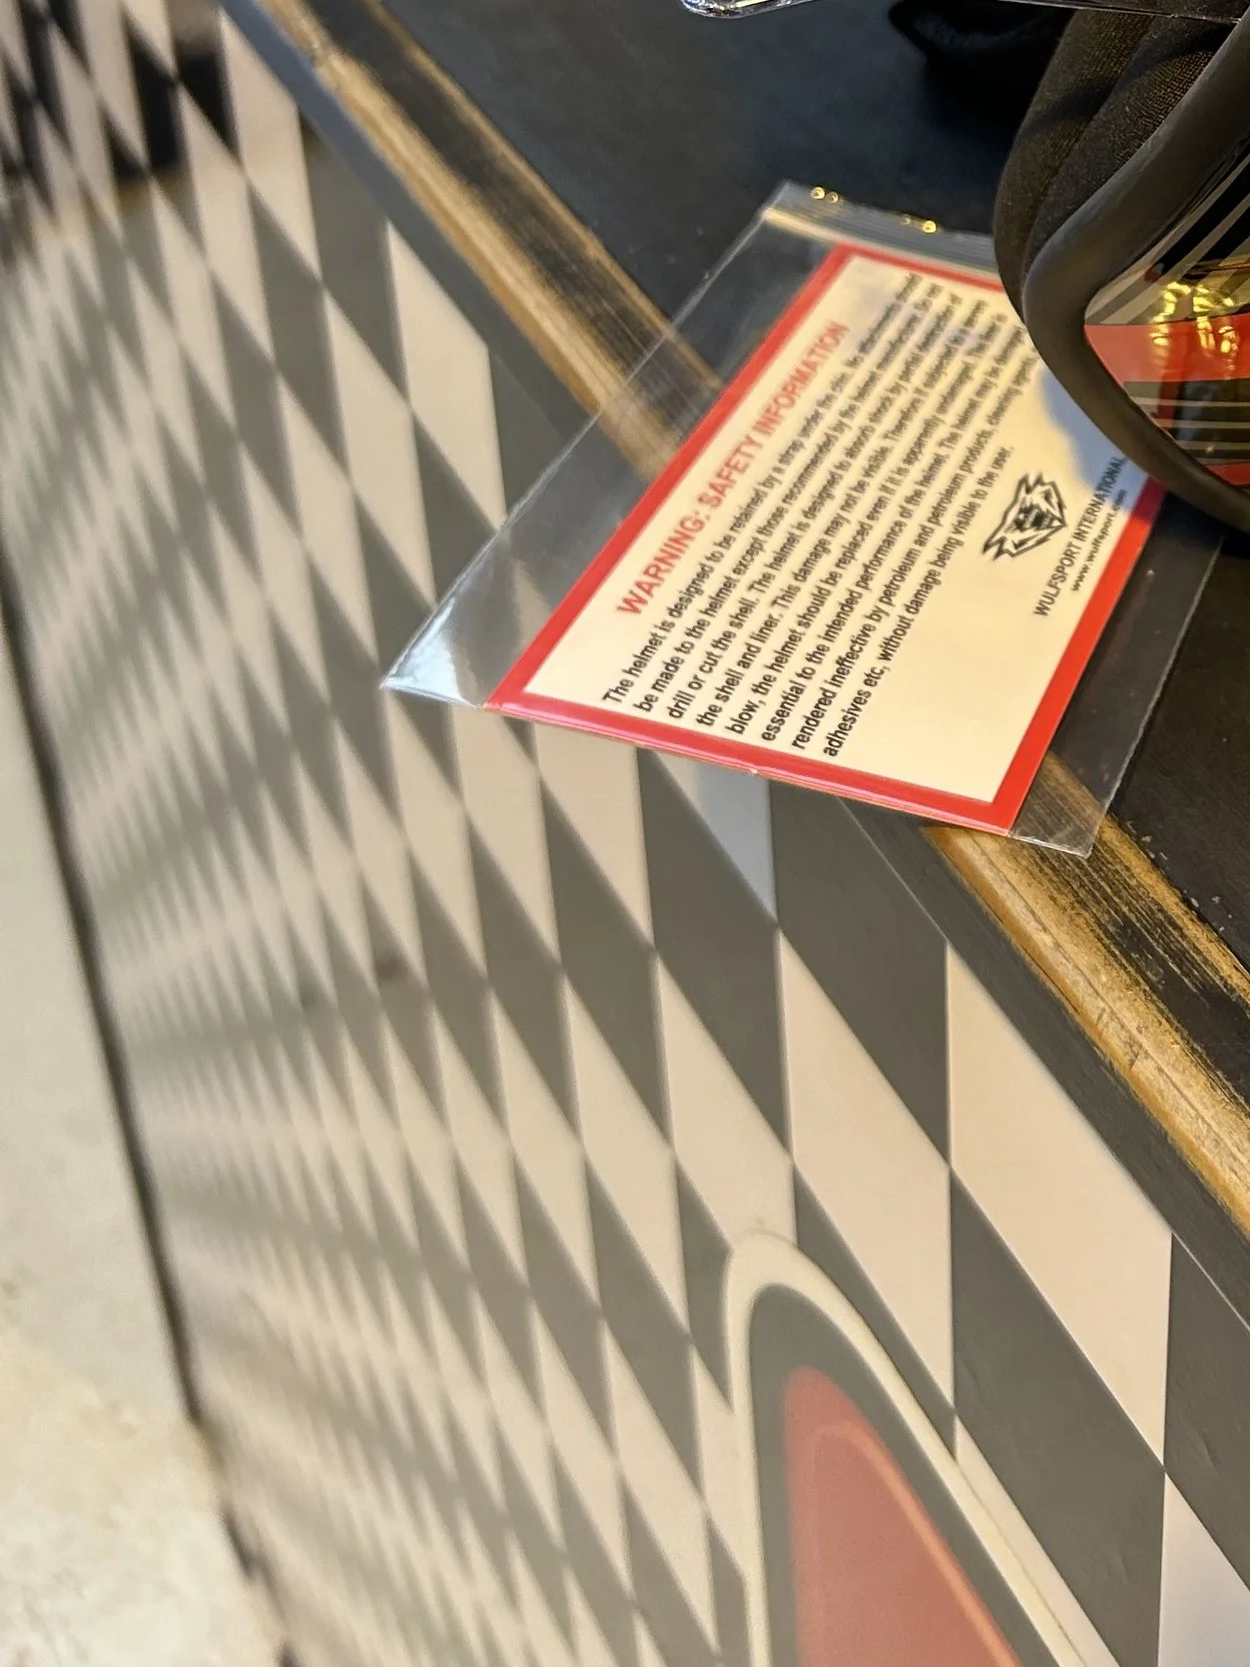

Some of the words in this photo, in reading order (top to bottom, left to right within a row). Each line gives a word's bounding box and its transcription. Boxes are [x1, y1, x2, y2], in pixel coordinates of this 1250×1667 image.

[776, 438, 806, 467] strap
[831, 459, 852, 472] to
[615, 510, 710, 615] WARNING:
[695, 432, 763, 509] SAFETY
[751, 320, 849, 436] INFORMATION
[755, 472, 783, 490] by
[770, 464, 785, 475] a
[780, 431, 839, 506] recommended
[883, 475, 903, 487] it
[889, 465, 910, 477] is
[975, 469, 999, 488] the
[800, 468, 844, 520] designed
[847, 478, 870, 495] be
[877, 482, 897, 496] if
[902, 487, 926, 507] the
[924, 471, 967, 527] petroleum
[968, 487, 989, 501] to
[727, 486, 768, 534] retained
[838, 491, 860, 513] not
[864, 494, 889, 522] even
[897, 503, 914, 519] of
[754, 504, 789, 537] those
[789, 519, 811, 533] is
[822, 511, 851, 538] may
[950, 500, 981, 535] visible
[711, 533, 737, 551] be
[832, 519, 874, 570] replaced
[912, 523, 935, 548] and
[1031, 540, 1082, 617] WULFSPORT
[1069, 456, 1127, 543] INTERNATIONAL
[703, 549, 725, 563] to
[730, 535, 768, 576] except
[762, 530, 803, 571] helmet
[790, 537, 832, 583] damage
[853, 518, 907, 591] performance
[927, 535, 965, 569] being
[665, 561, 715, 619] designed
[745, 570, 776, 594] The
[818, 569, 843, 587] be
[876, 546, 922, 608] petroleum
[697, 574, 740, 618] helmet
[768, 583, 801, 609] This
[902, 567, 942, 615] damage
[795, 583, 832, 629] should
[816, 587, 863, 643] intended
[862, 603, 891, 623] by
[652, 618, 676, 633] is
[683, 617, 711, 640] the
[876, 613, 915, 662] without
[672, 639, 695, 655] to
[709, 629, 737, 652] the
[762, 627, 806, 673] helmet
[803, 642, 831, 665] the
[620, 631, 667, 678] helmet
[697, 649, 723, 674] cut
[735, 641, 762, 670] and
[822, 622, 877, 689] ineffective
[649, 655, 685, 693] made
[686, 672, 706, 691] or
[713, 667, 745, 703] shell
[749, 673, 777, 696] the
[794, 665, 817, 681] to
[600, 677, 635, 703] The
[631, 692, 659, 713] be
[665, 688, 696, 719] drill
[694, 703, 723, 727] the
[760, 678, 807, 742] essential
[790, 685, 838, 750] rendered
[821, 688, 872, 757] adhesives
